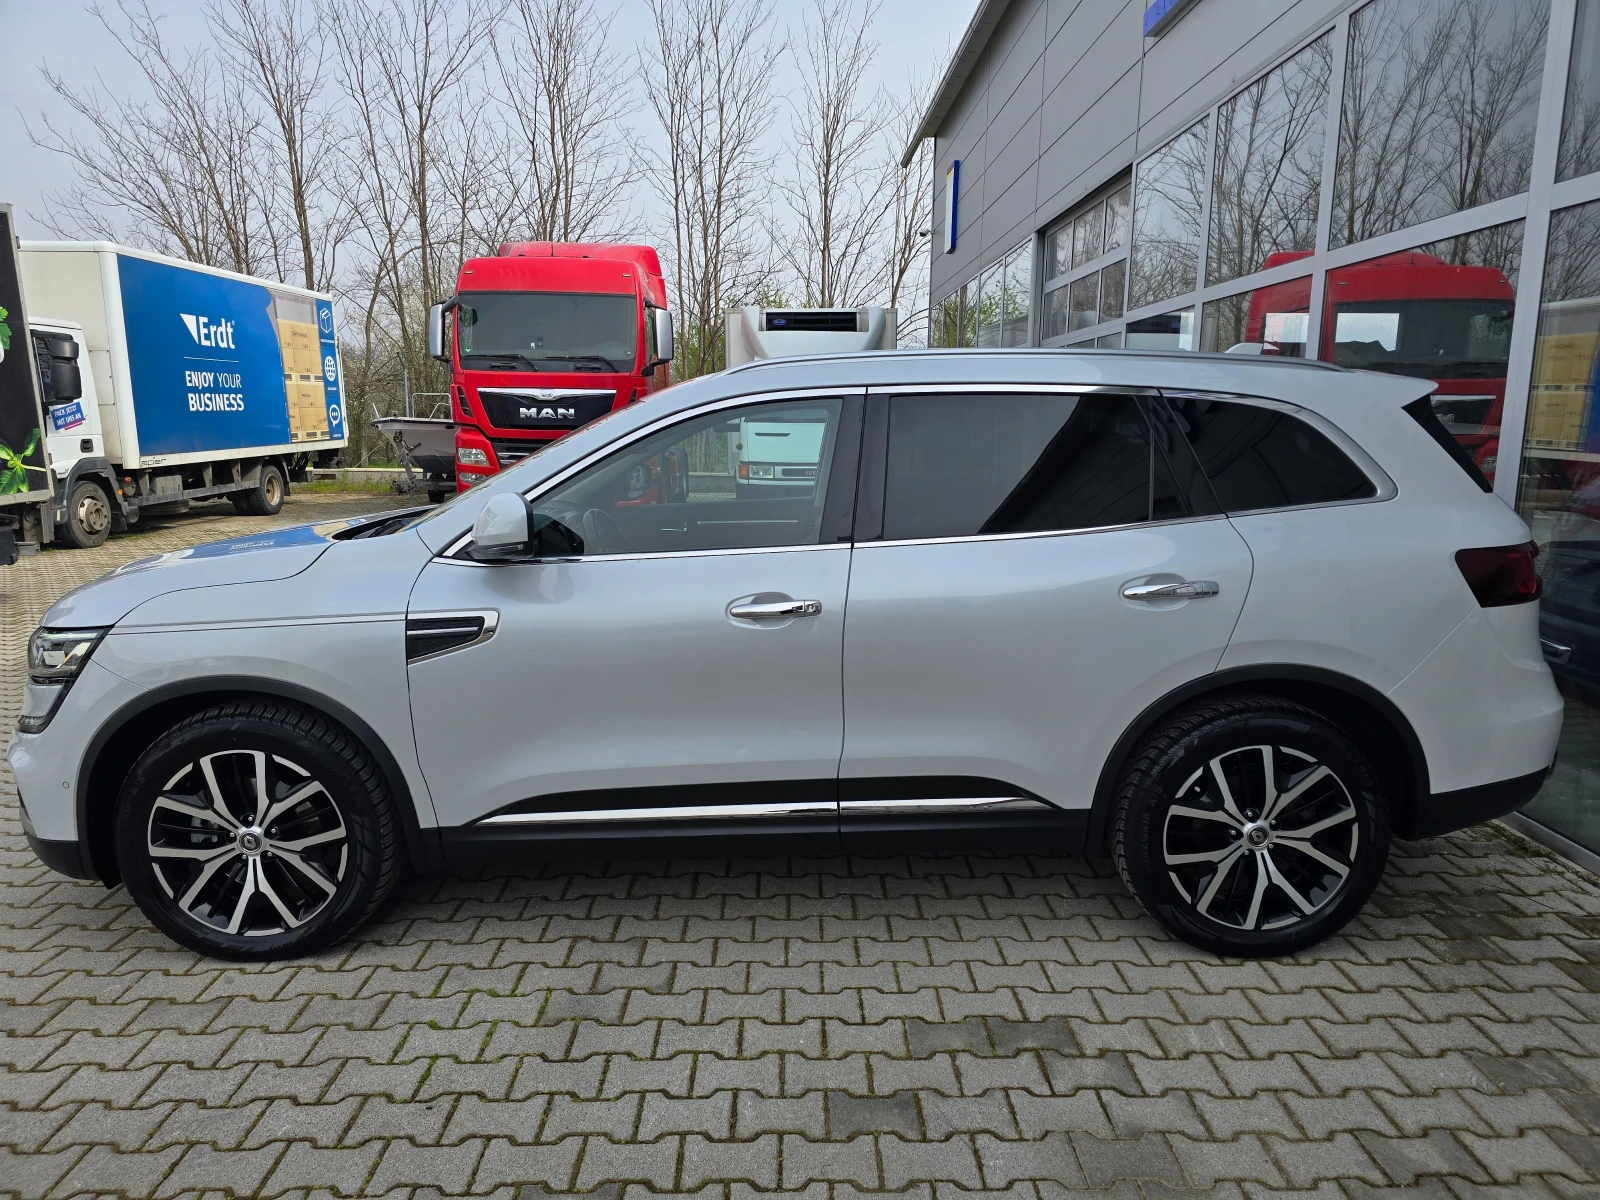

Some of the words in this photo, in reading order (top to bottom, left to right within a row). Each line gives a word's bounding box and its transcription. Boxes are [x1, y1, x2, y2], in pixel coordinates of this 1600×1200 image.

[198, 316, 235, 349] Erdt
[185, 370, 214, 389] ENJOY
[216, 372, 242, 388] YOUR
[188, 393, 244, 411] BUSINESS
[520, 407, 575, 419] MAN
[141, 456, 167, 467] spier
